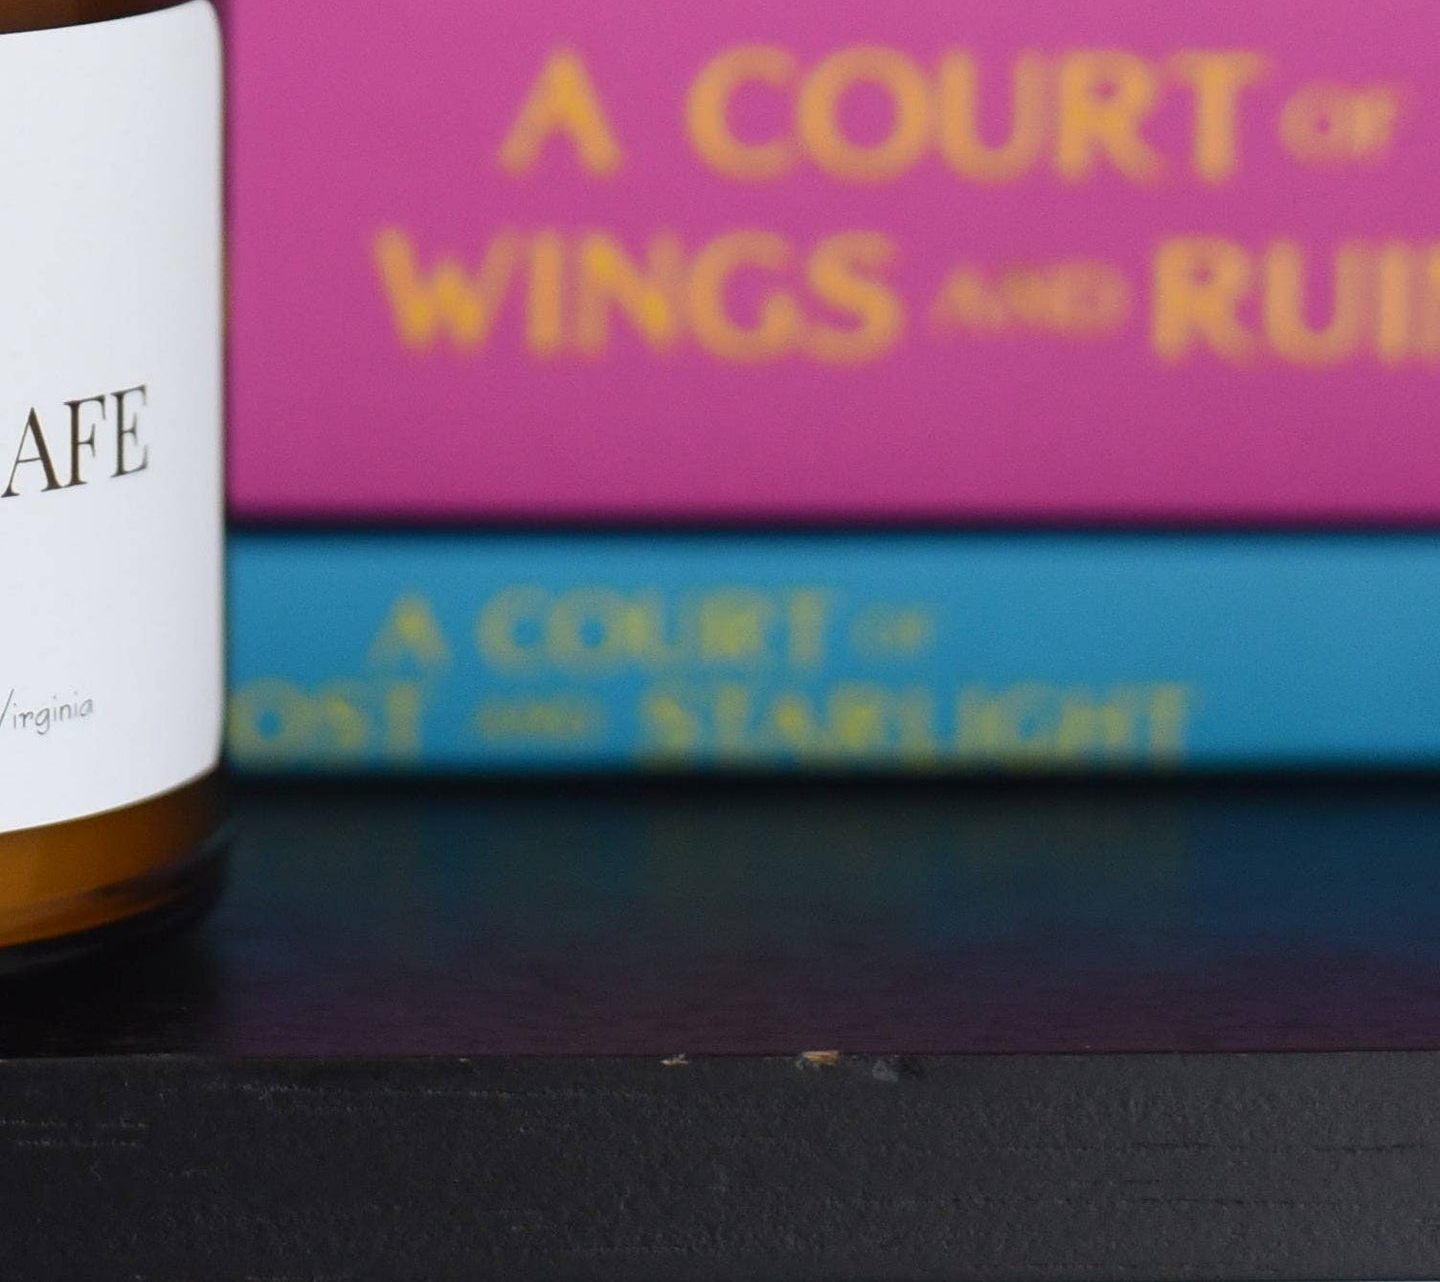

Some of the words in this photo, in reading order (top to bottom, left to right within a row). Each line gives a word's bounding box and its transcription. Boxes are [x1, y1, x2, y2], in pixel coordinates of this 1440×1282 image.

[495, 46, 625, 180] A
[681, 46, 1274, 188] COURT
[370, 227, 908, 367] WINGS
[363, 589, 453, 670] A
[475, 583, 841, 679] COURT
[228, 677, 437, 773] OST
[637, 679, 1194, 775] STARLIGHT
